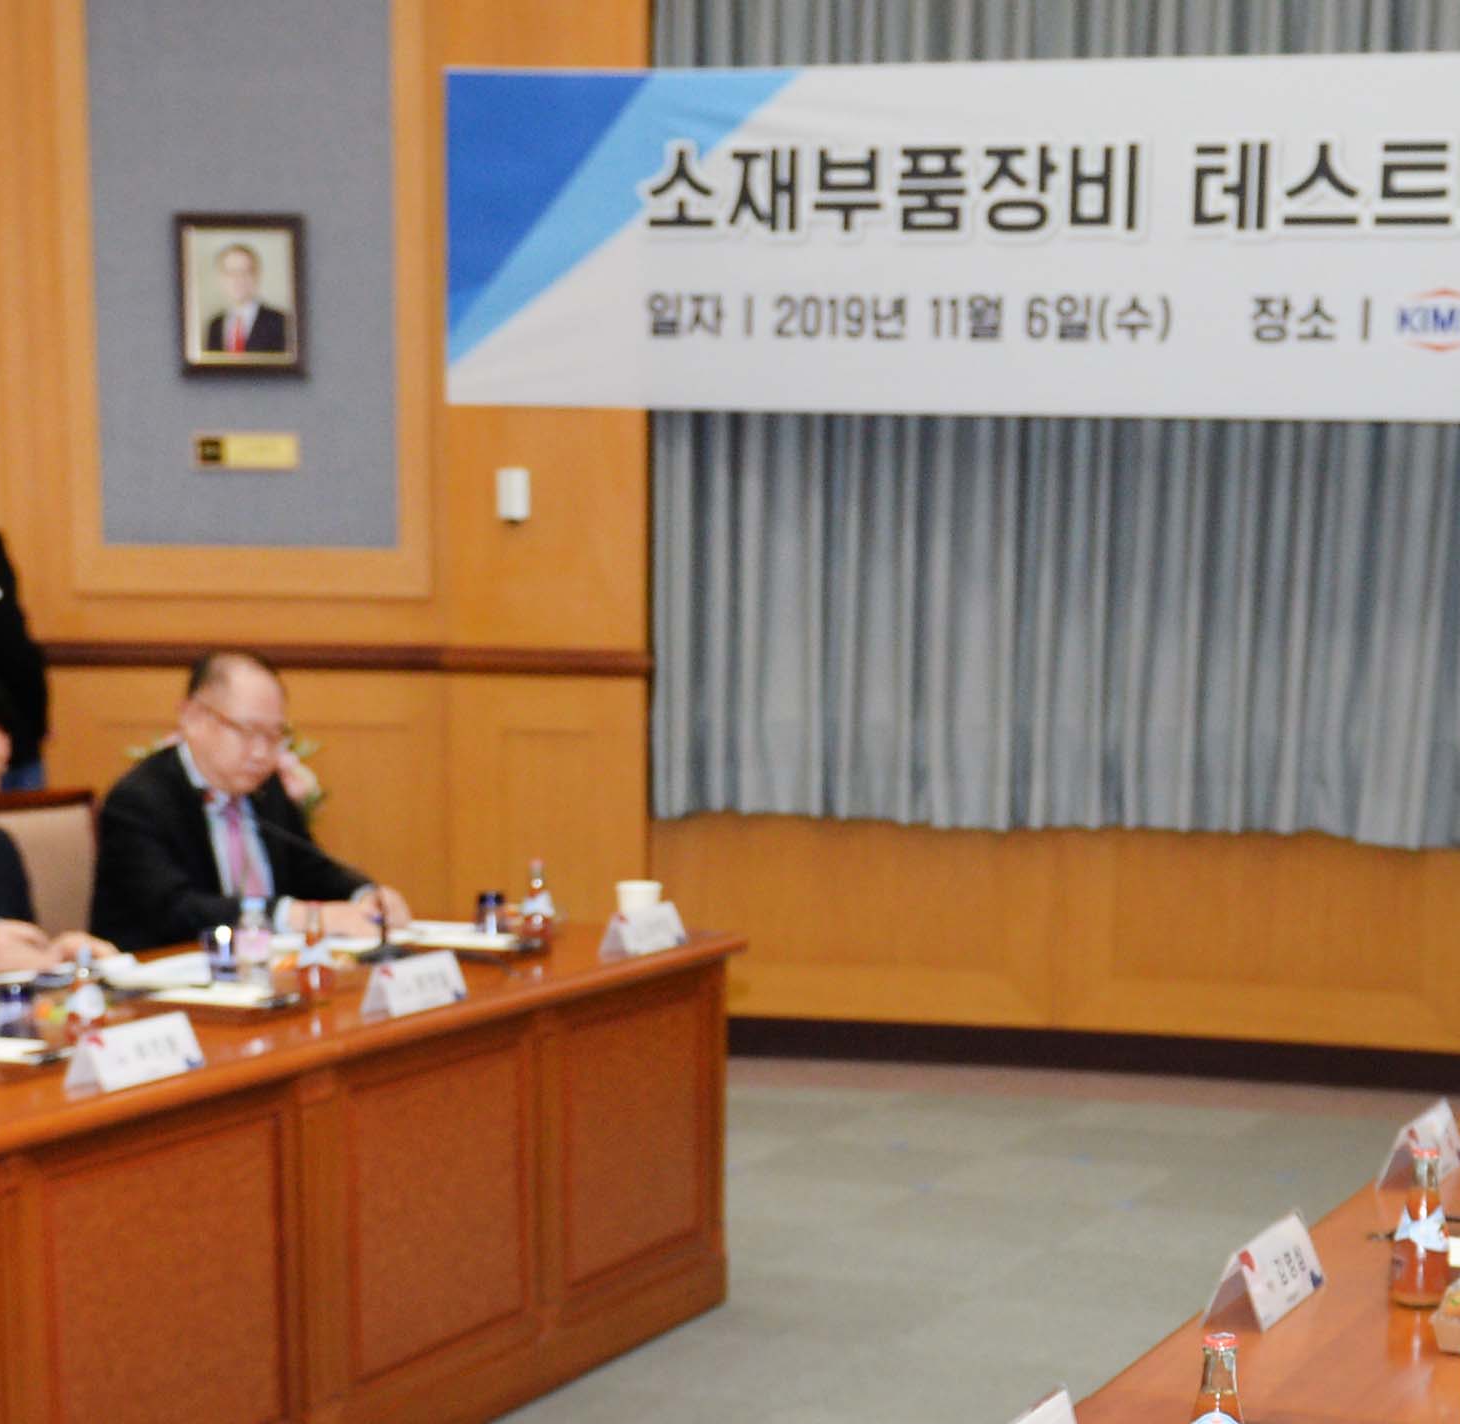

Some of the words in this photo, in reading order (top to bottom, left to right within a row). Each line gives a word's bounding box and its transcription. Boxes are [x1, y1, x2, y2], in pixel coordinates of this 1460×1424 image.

[648, 144, 1139, 232] 소재부품장비
[648, 293, 724, 339] 일자
[774, 294, 906, 340] 2019년
[930, 295, 1003, 340] 11월
[1027, 294, 1172, 342] 6일(수)
[1251, 294, 1337, 345] 장소
